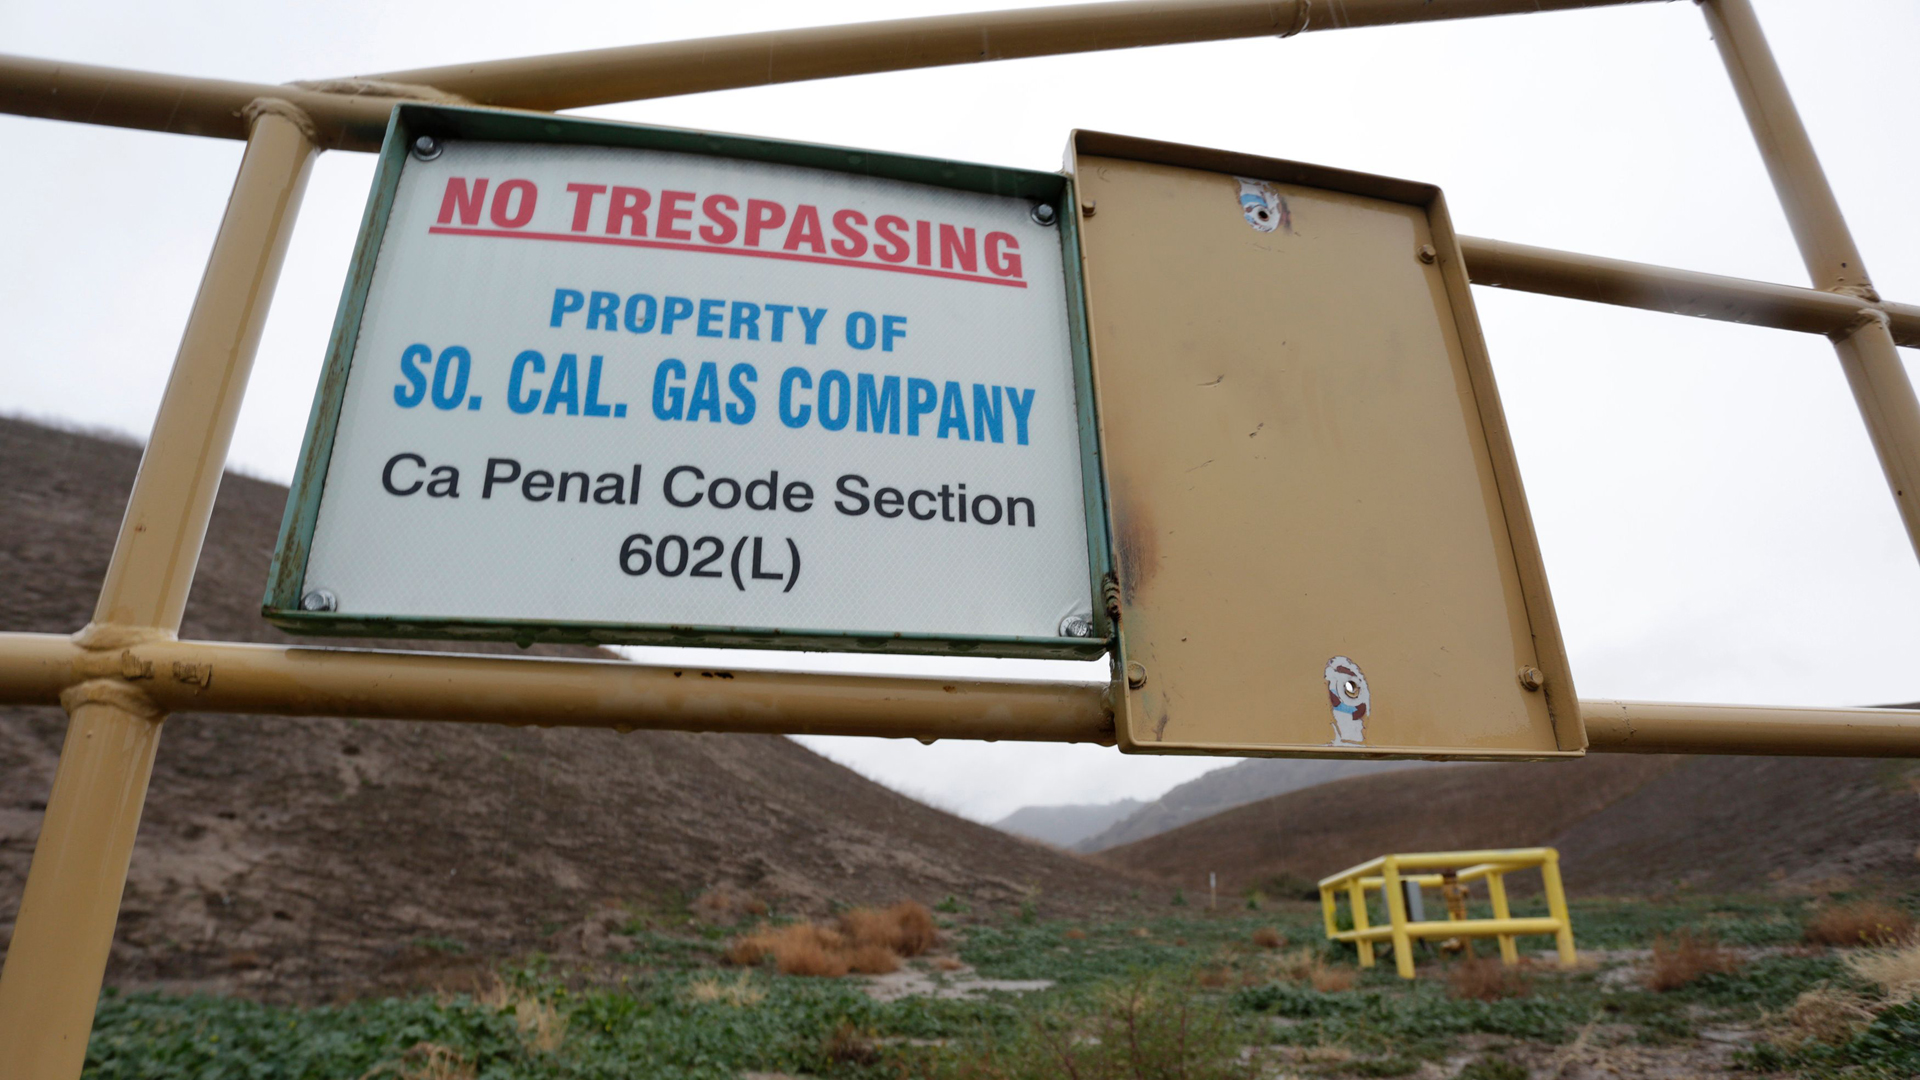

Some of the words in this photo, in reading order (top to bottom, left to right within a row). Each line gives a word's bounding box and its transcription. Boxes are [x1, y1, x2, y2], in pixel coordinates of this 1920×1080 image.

[437, 176, 538, 233] NO
[566, 182, 1023, 279] TRESPASSING
[549, 287, 828, 346] PROPERTY
[845, 310, 908, 353] OF
[393, 342, 482, 412] SO.
[507, 349, 628, 419] CAL.
[652, 357, 759, 426] GAS
[779, 365, 1036, 447] COMPANY
[381, 451, 460, 499] Ca
[481, 457, 642, 507] Penal
[662, 464, 815, 515] Code
[834, 473, 1036, 528] Section
[618, 532, 801, 594] 602(L)
